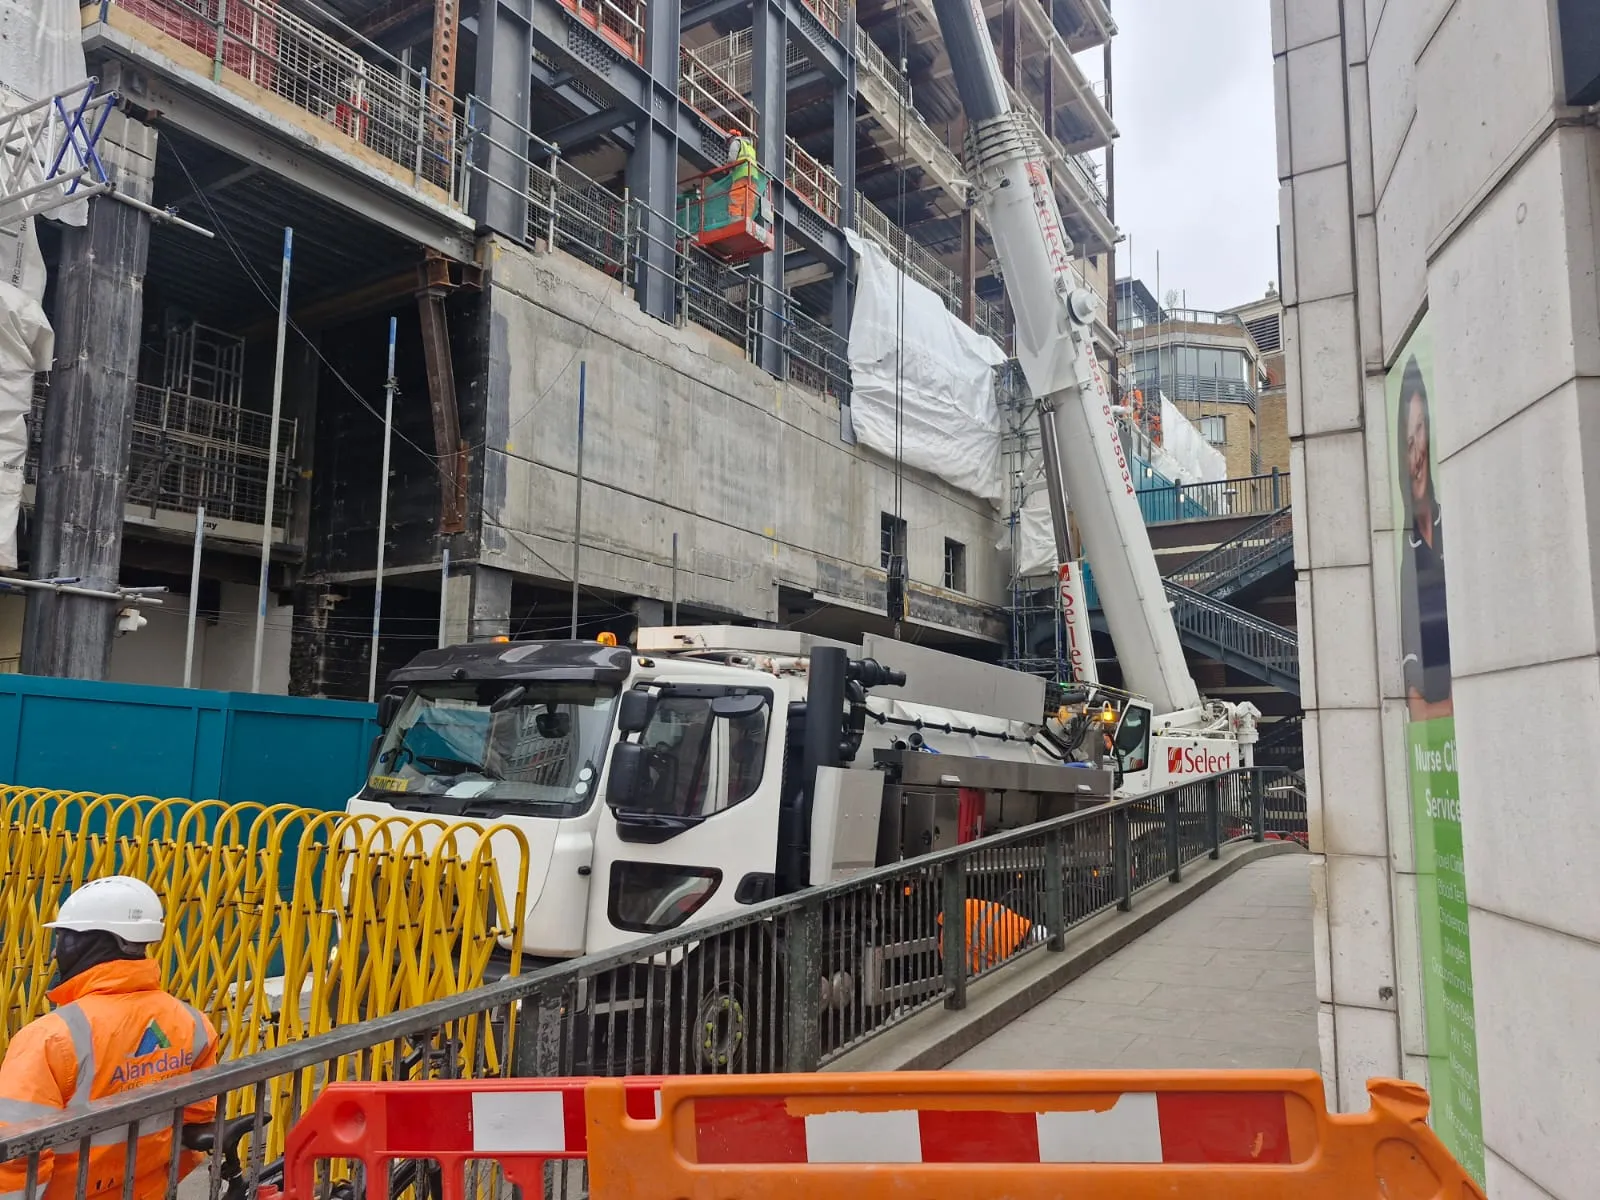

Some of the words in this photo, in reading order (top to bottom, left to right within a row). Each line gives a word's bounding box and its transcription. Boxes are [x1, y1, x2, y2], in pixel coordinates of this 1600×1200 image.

[1102, 404, 1134, 496] 8735934
[1060, 584, 1083, 683] Selec
[1184, 747, 1231, 774] Select
[1414, 743, 1441, 773] Nurse
[110, 1049, 193, 1085] Alandale
